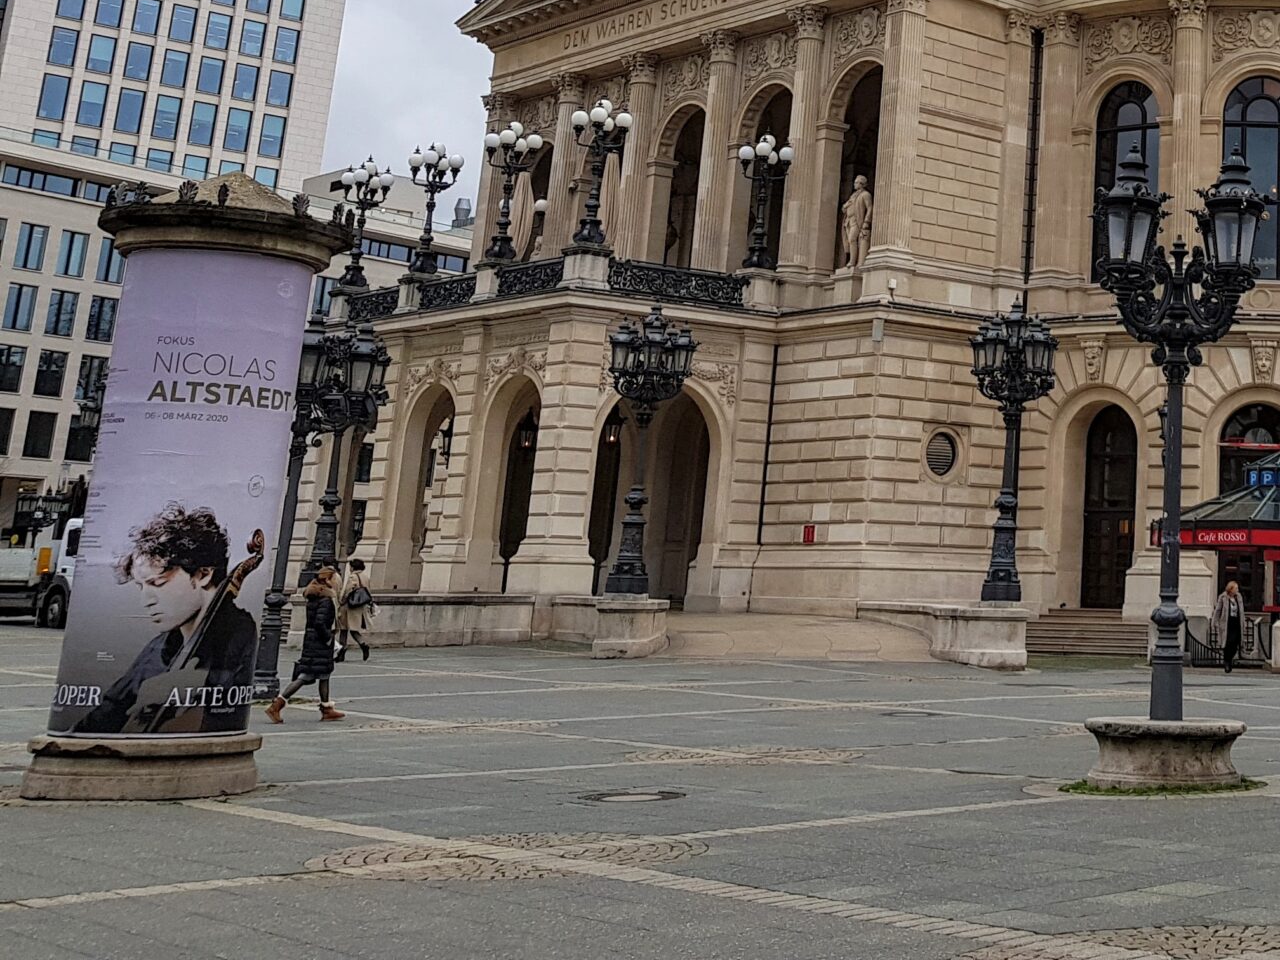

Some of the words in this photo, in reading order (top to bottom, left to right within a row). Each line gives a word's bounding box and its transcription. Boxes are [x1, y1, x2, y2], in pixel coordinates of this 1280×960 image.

[563, 27, 591, 50] DEM
[596, 7, 653, 41] WAHREN
[156, 336, 195, 346] FOKUS
[153, 351, 277, 381] NICOLAS
[147, 380, 292, 411] ALTSTAEDT
[144, 412, 156, 420] 06
[162, 412, 174, 421] 08
[175, 411, 203, 422] MÄRZ
[206, 414, 229, 422] 2020
[1263, 474, 1272, 485] P
[1198, 532, 1216, 543] Café
[1217, 532, 1247, 542] ROSSO
[58, 684, 102, 706] OPER
[163, 686, 224, 707] ALTE
